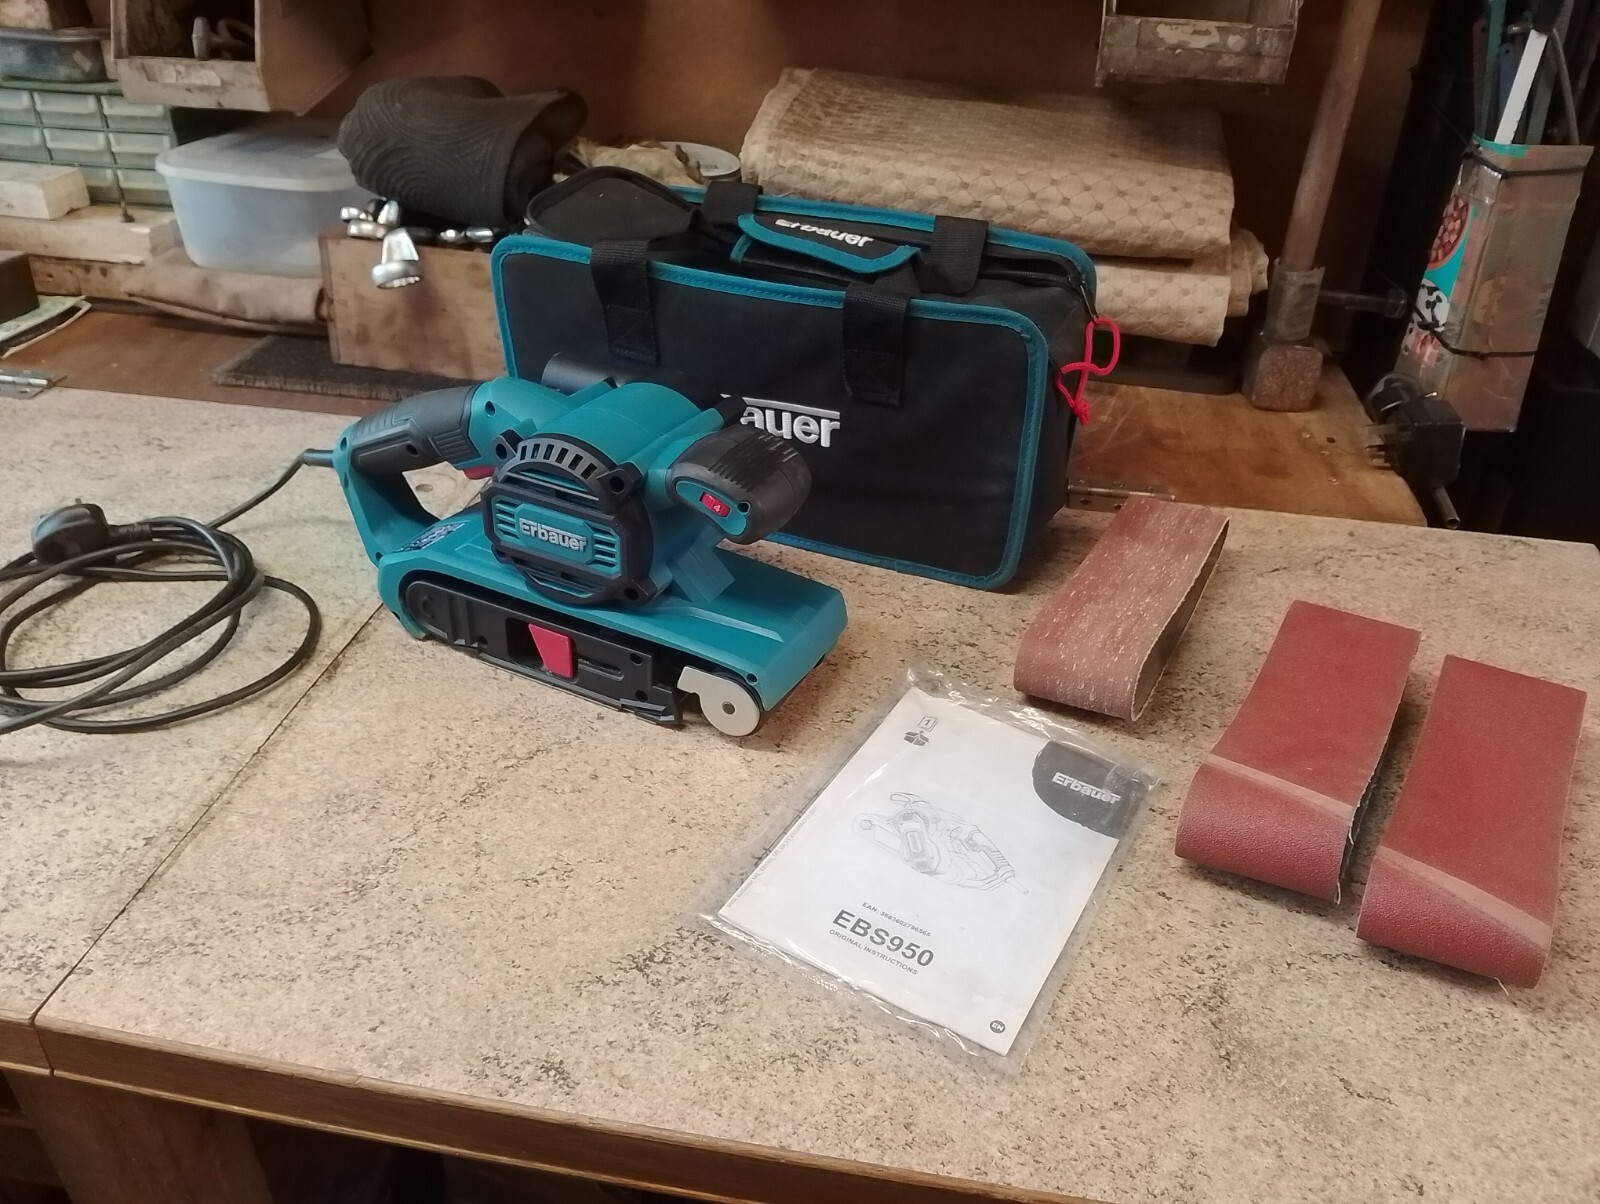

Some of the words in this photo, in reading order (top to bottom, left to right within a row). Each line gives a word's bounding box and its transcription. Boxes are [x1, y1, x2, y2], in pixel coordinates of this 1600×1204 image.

[720, 393, 841, 448] auer
[519, 517, 587, 552] Erbauer
[1052, 771, 1121, 804] Erbauer
[862, 902, 879, 913] EAN:
[829, 929, 863, 949] ORIGINAL
[863, 946, 918, 975] INSTRUCTIONS
[832, 909, 934, 967] EBS950
